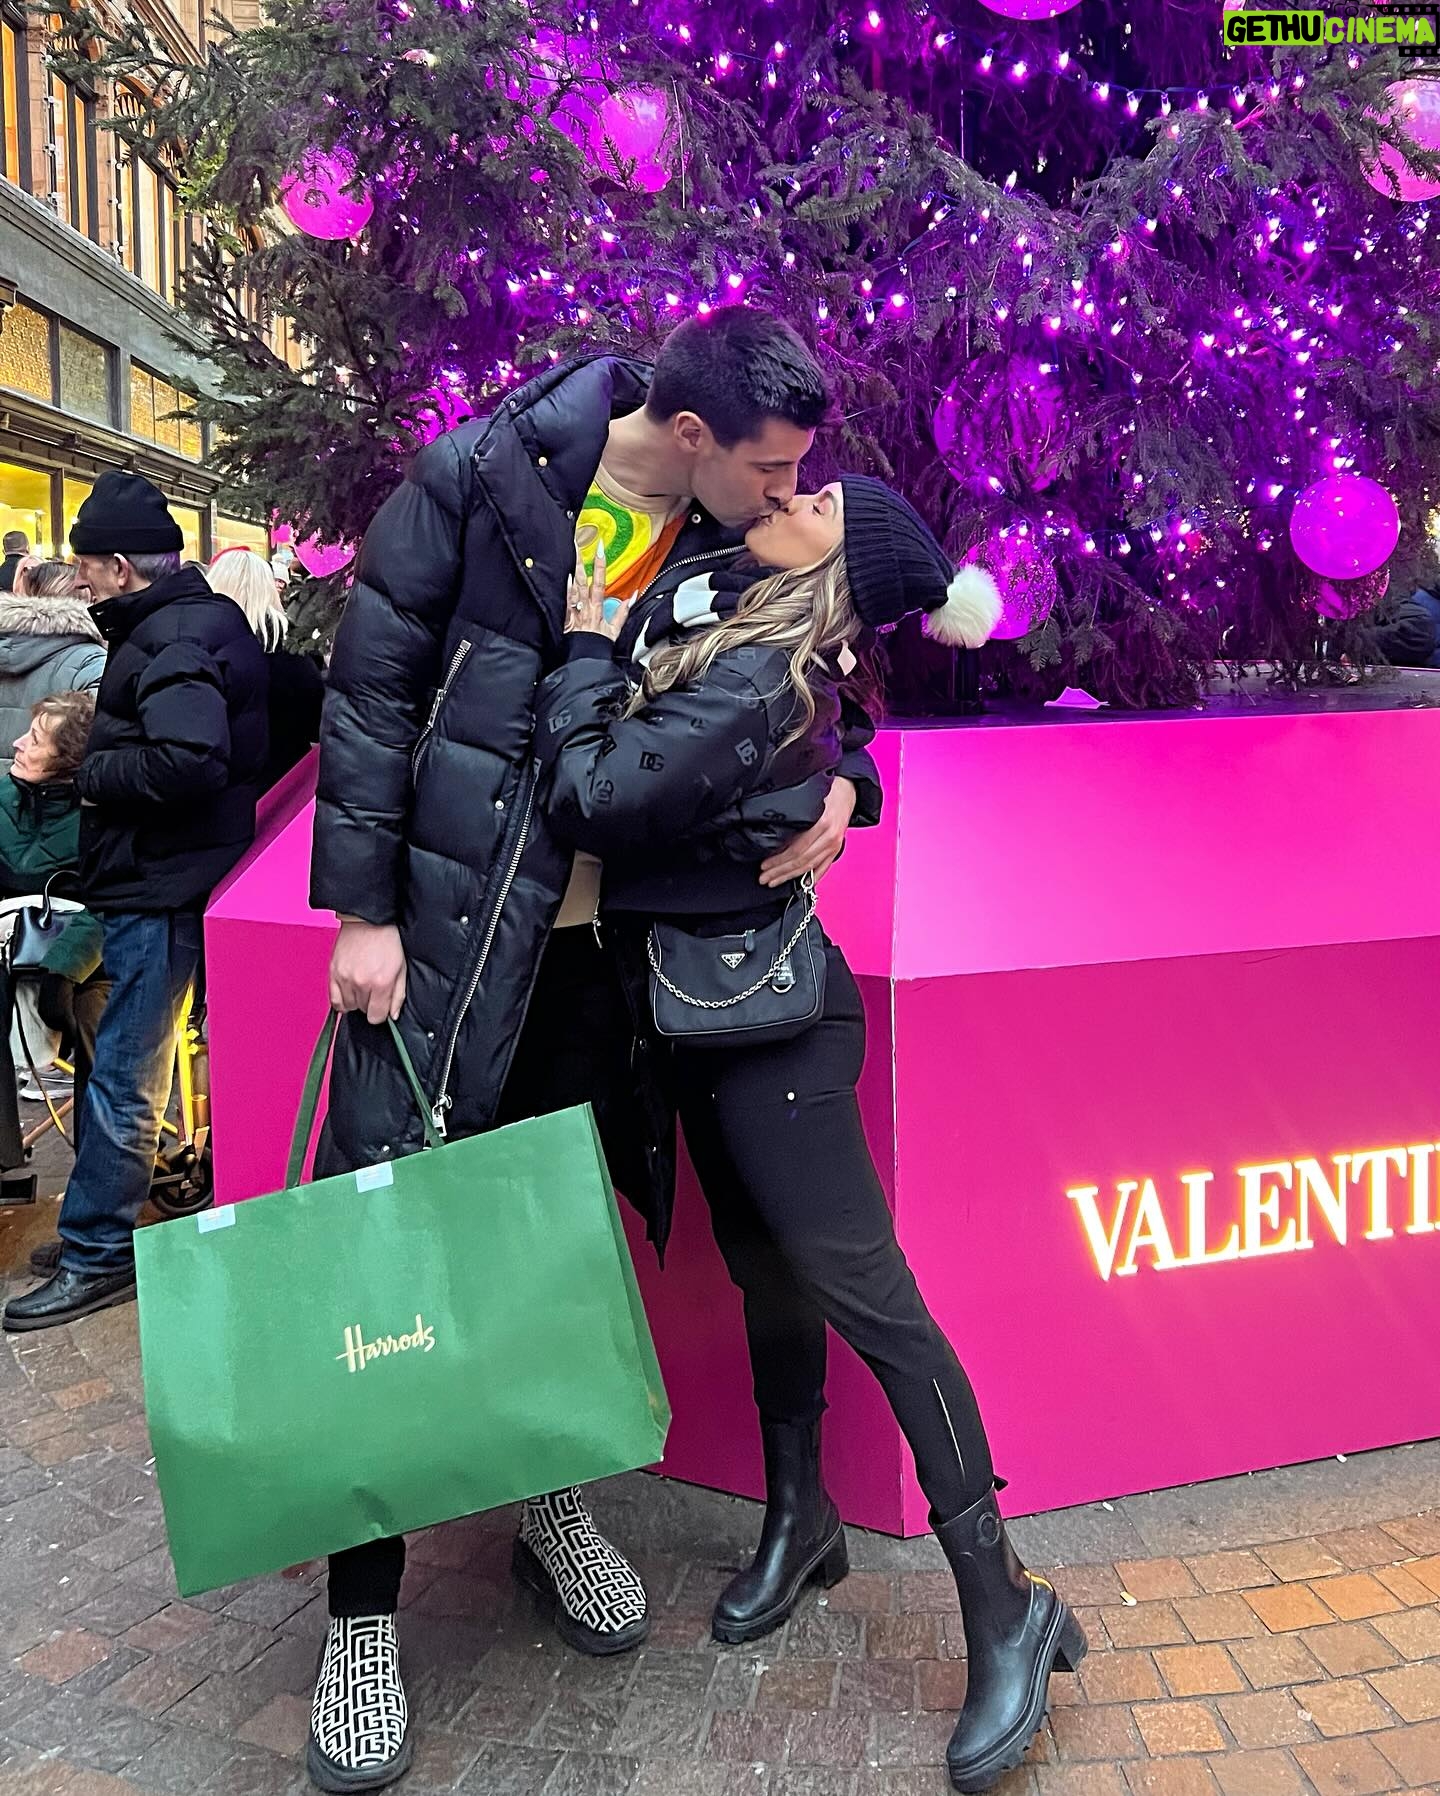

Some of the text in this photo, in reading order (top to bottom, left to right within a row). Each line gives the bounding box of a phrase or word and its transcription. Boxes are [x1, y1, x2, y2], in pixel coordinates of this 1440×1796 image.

[639, 751, 664, 772] DG
[1066, 1143, 1440, 1281] VALENTI
[335, 1313, 436, 1373] Harrods
